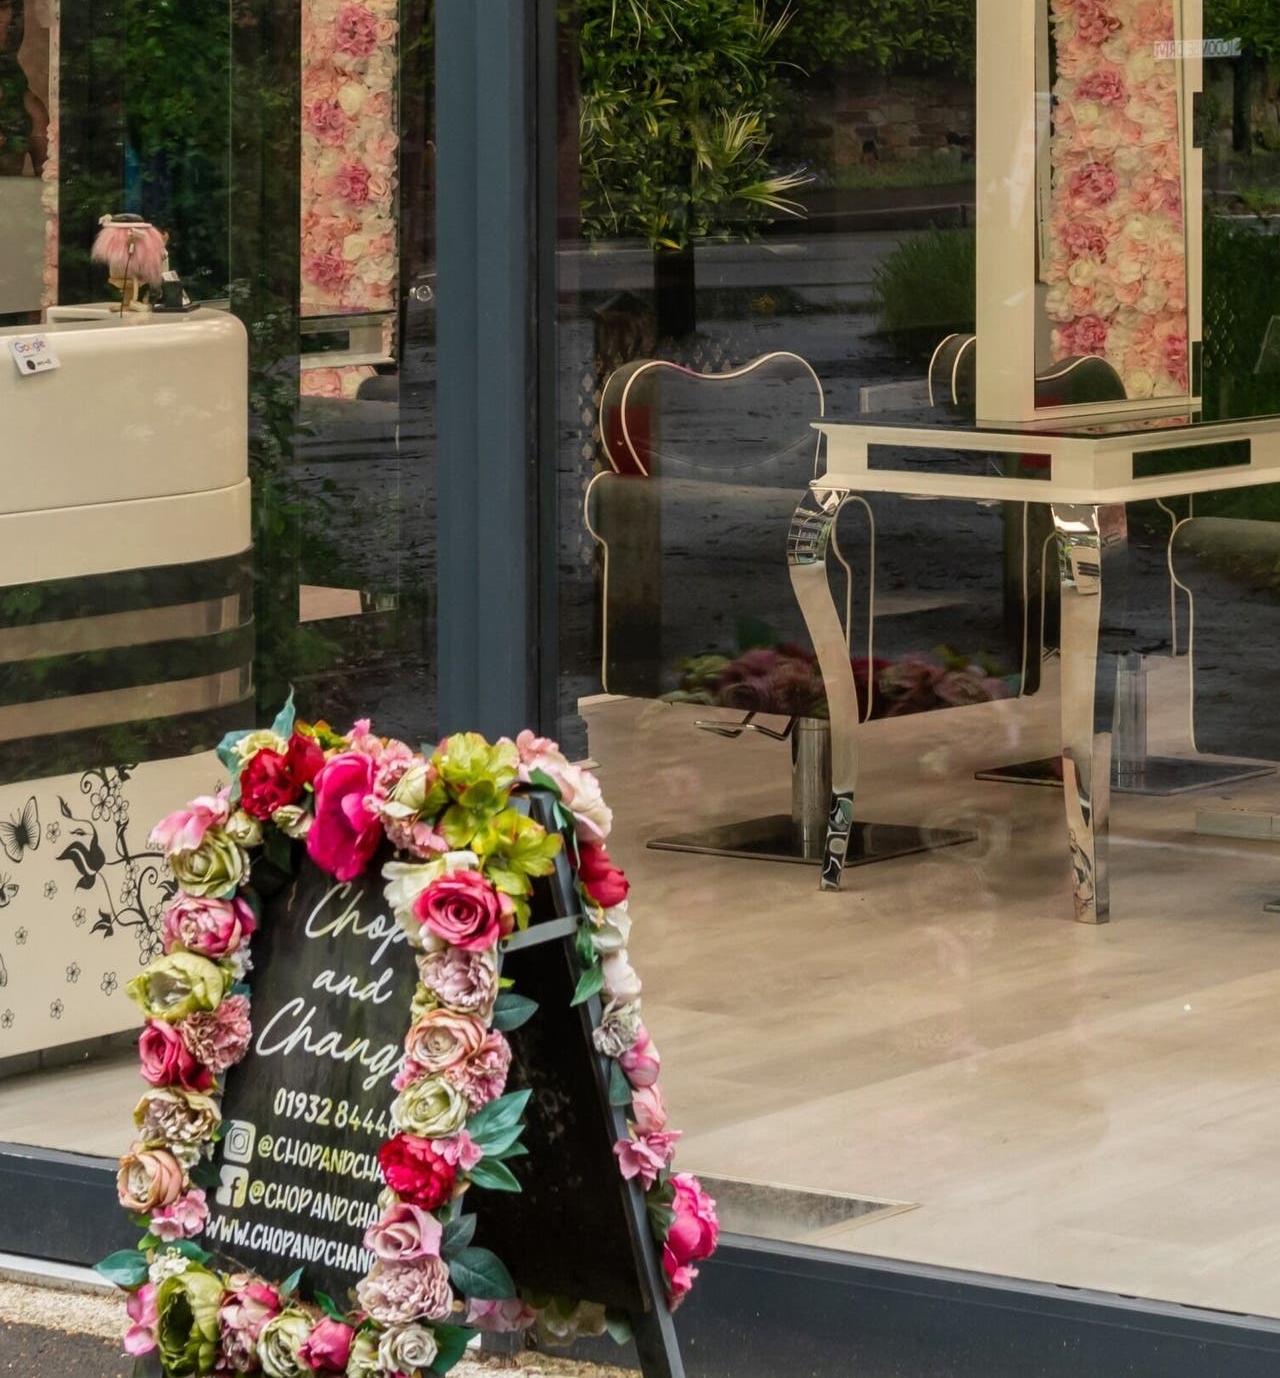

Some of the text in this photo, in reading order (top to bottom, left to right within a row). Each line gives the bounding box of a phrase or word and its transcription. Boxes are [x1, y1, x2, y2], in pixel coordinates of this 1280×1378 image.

[14, 337, 46, 352] Google
[305, 881, 408, 966] Chop
[312, 967, 394, 1004] and
[273, 1087, 333, 1126] 01932
